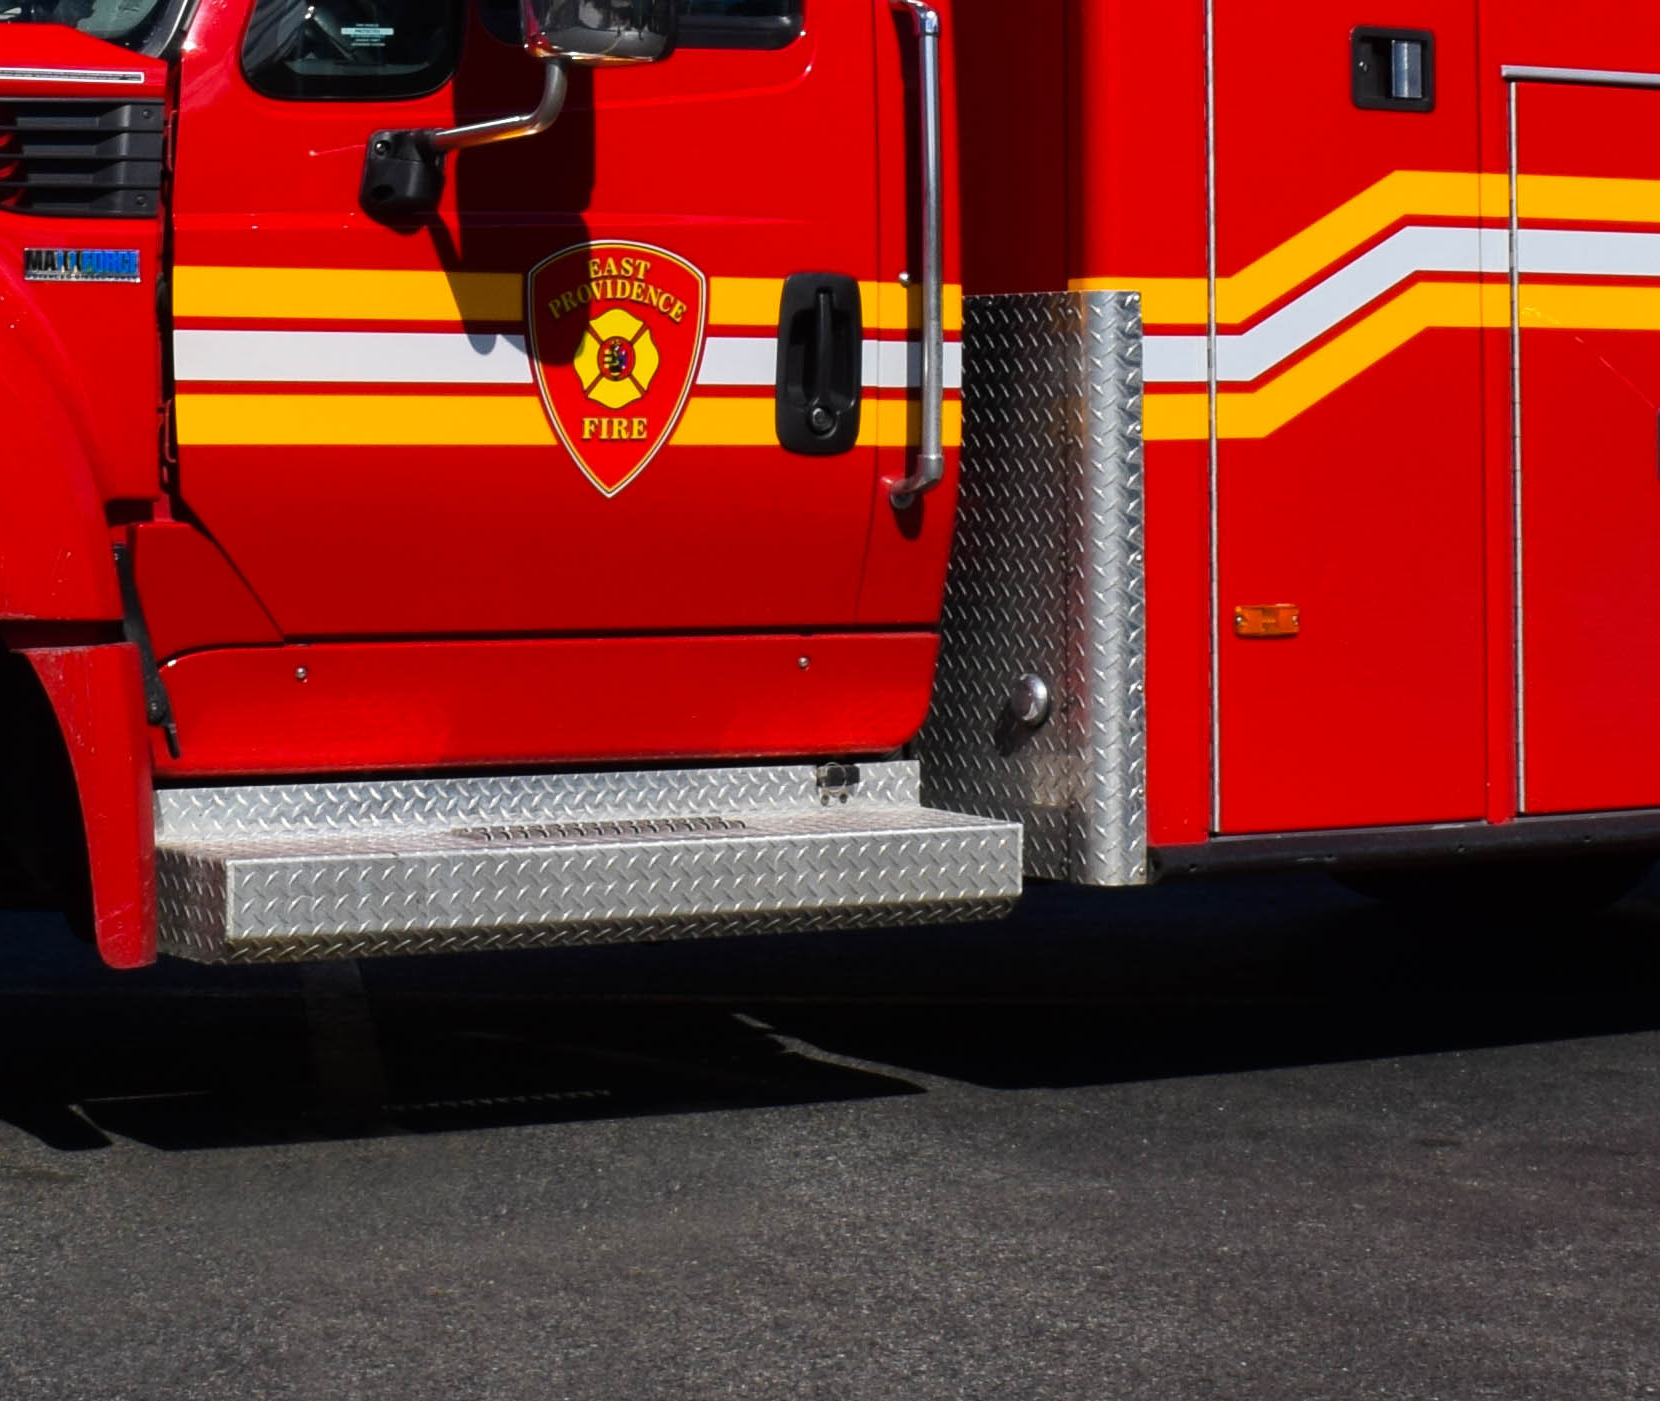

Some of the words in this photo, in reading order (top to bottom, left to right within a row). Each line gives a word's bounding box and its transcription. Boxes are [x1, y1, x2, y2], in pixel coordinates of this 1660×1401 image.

[588, 257, 651, 280] EAST
[548, 281, 689, 323] PROVIDENCE
[581, 416, 649, 441] FIRE
